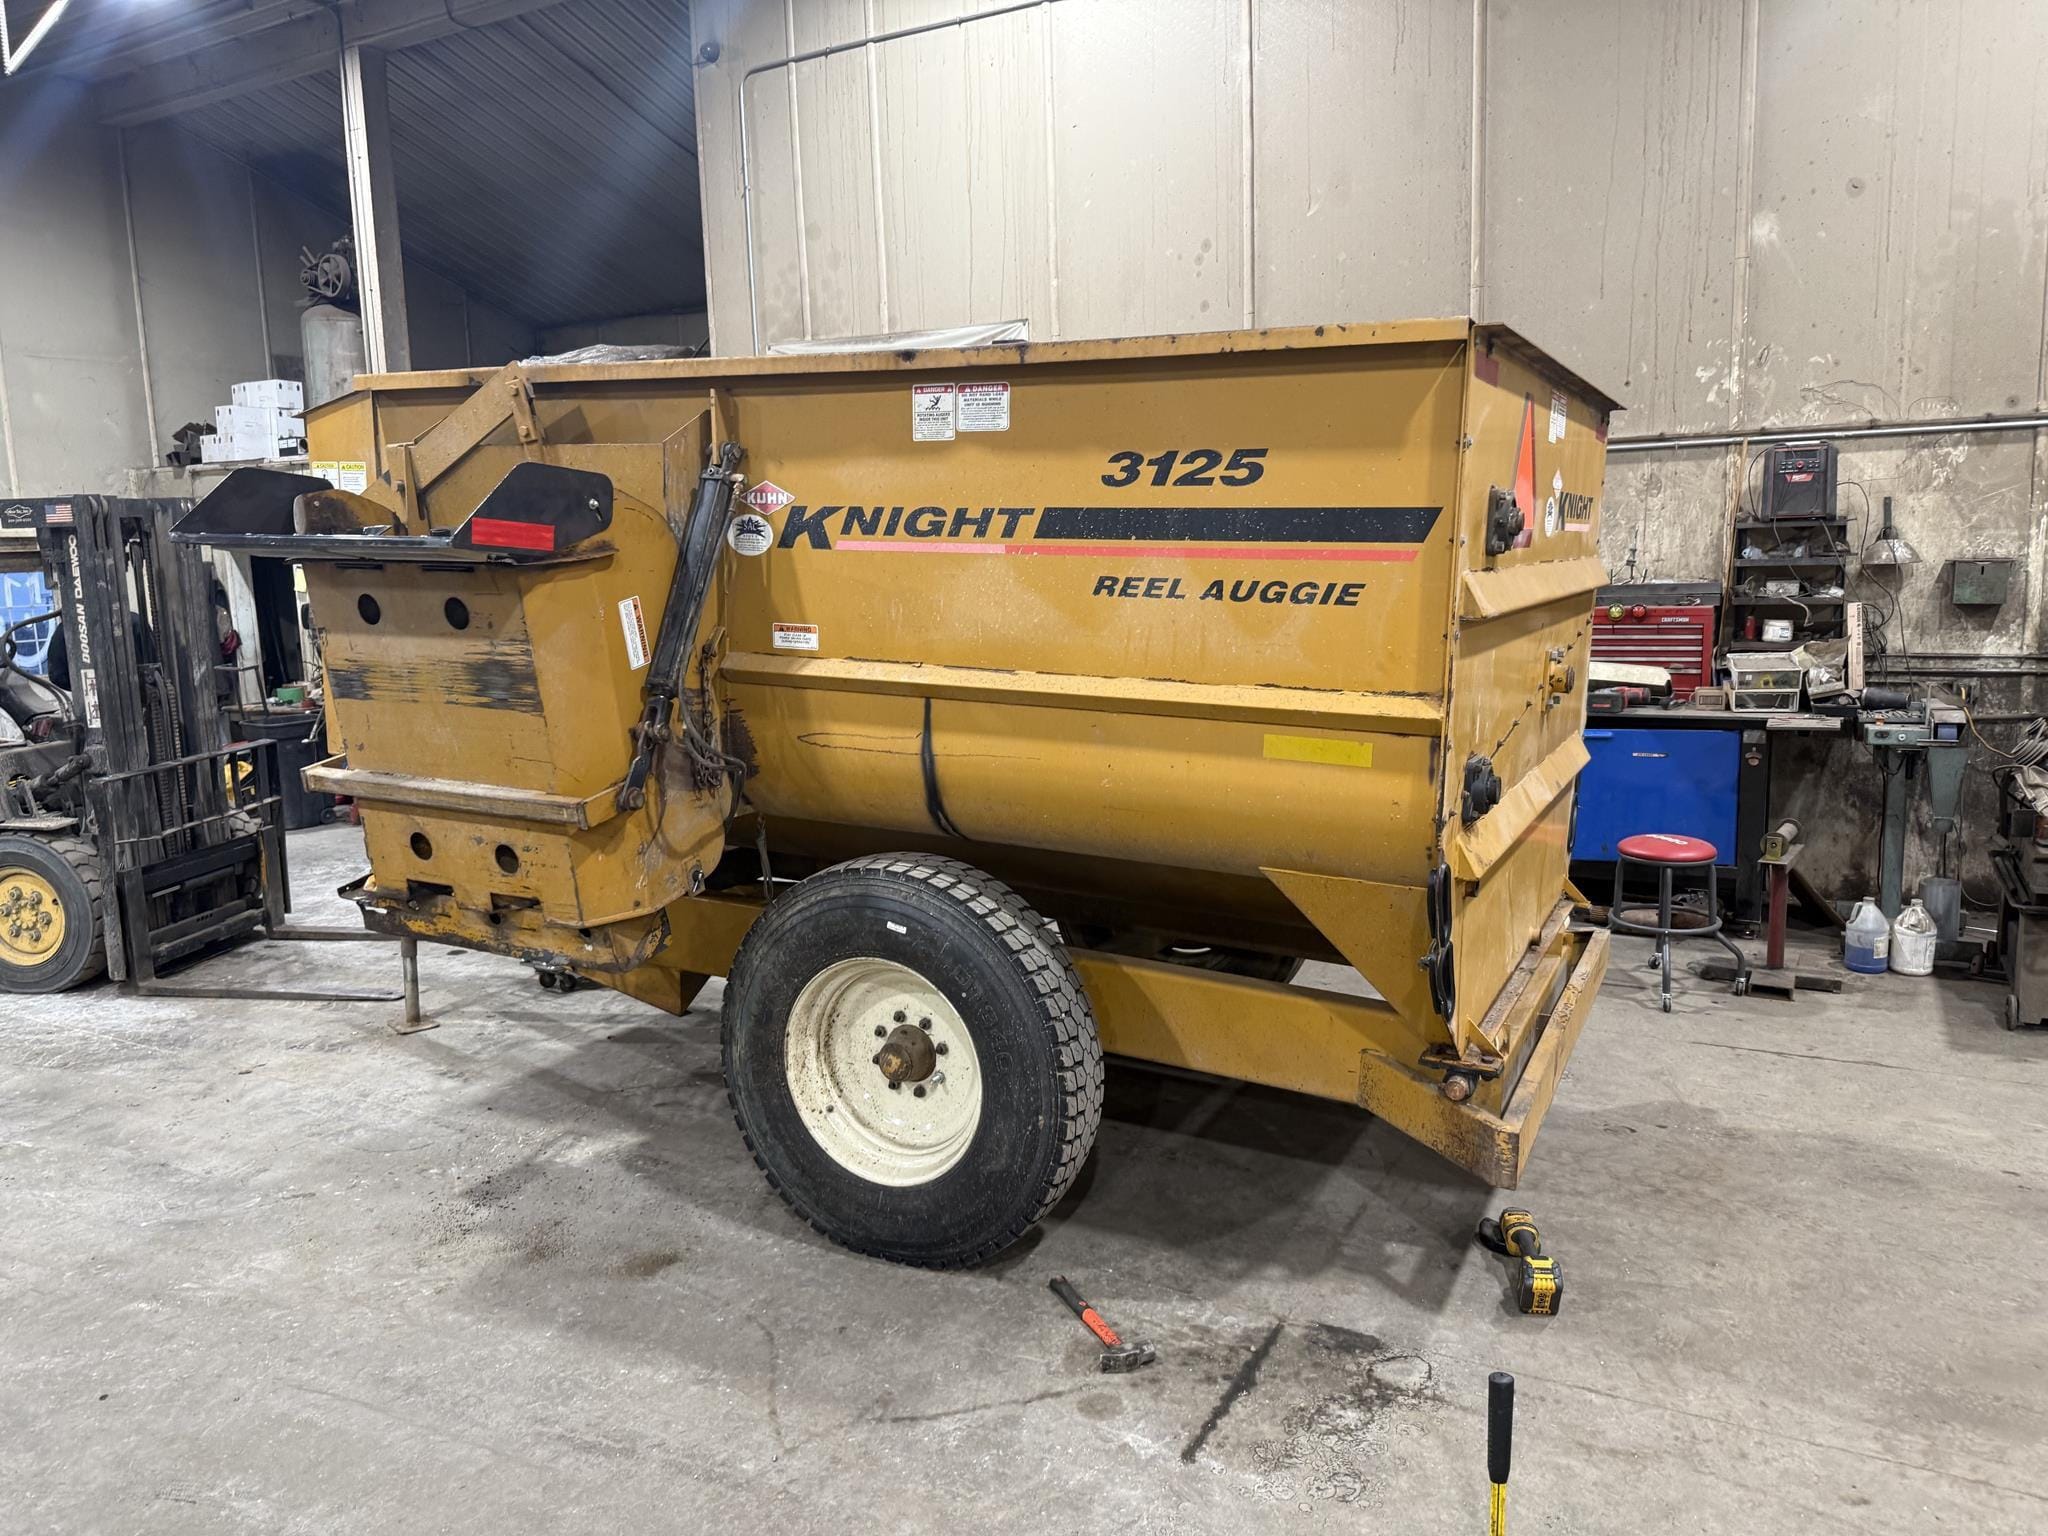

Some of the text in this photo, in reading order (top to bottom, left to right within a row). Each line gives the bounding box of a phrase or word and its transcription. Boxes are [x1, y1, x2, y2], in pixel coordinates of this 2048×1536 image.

[1101, 448, 1269, 488] 3125
[746, 492, 788, 505] KUHN
[1556, 491, 1594, 531] KNIGHT
[776, 506, 1035, 550] KNIGHT
[68, 534, 83, 598] DAEWOO
[1093, 576, 1367, 607] REEL AUGGIE
[76, 603, 90, 664] DOOSAN
[636, 613, 649, 659] WARNING
[784, 625, 812, 633] WARNING
